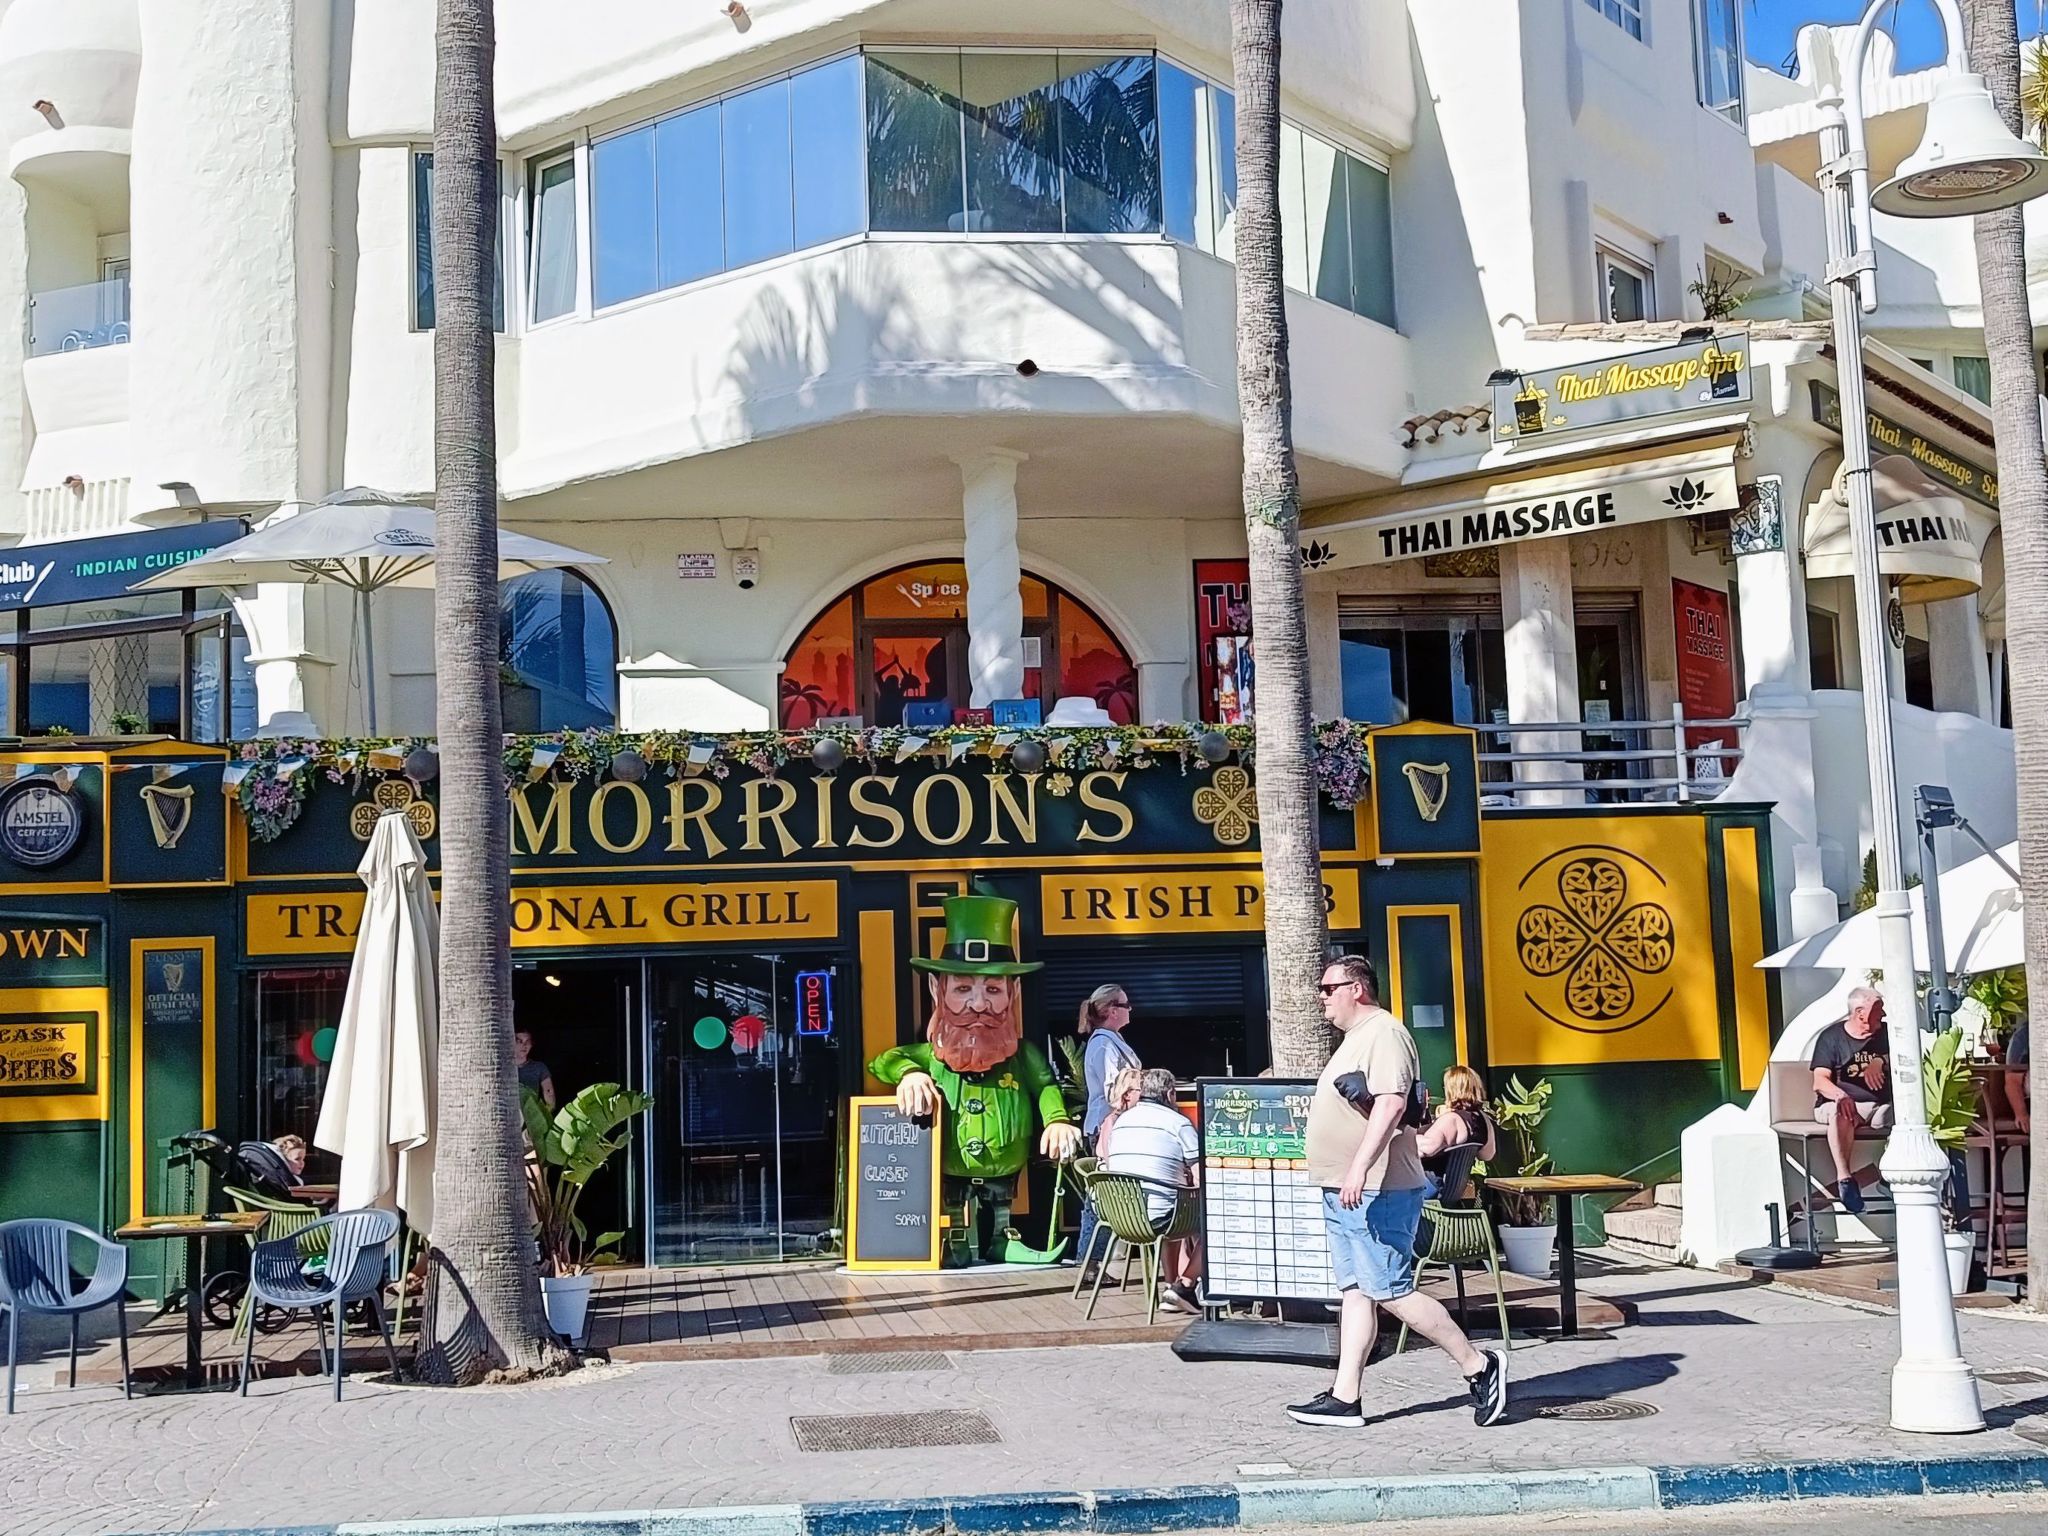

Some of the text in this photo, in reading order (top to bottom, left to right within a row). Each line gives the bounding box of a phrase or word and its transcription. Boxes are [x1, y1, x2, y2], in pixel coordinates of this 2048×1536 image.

[1557, 346, 1745, 403] Thai Massage Spa
[1699, 384, 1737, 401] By Jamie
[1868, 415, 1998, 501] Thai Massage Sp
[1378, 493, 1616, 557] THAI MASSAGE
[1876, 516, 1947, 546] THAI
[0, 560, 36, 584] lub
[76, 556, 137, 577] INDIAN
[1685, 606, 1721, 640] THAI
[1686, 636, 1725, 661] MASSAGE
[14, 811, 64, 824] AMSTEL
[17, 828, 60, 837] CERVEZA
[278, 891, 811, 938] TRONAL GRILL
[1060, 886, 1214, 920] IRISH
[147, 1000, 200, 1010] IRISH PUB
[148, 992, 195, 1002] OFFICIAL
[806, 976, 820, 1031] OPEN
[1214, 1098, 1259, 1110] MORRISON'S
[1292, 1107, 1311, 1118] BA
[860, 1121, 919, 1146] KITCHEN
[888, 1152, 898, 1163] IS
[864, 1164, 910, 1183] CLOSED
